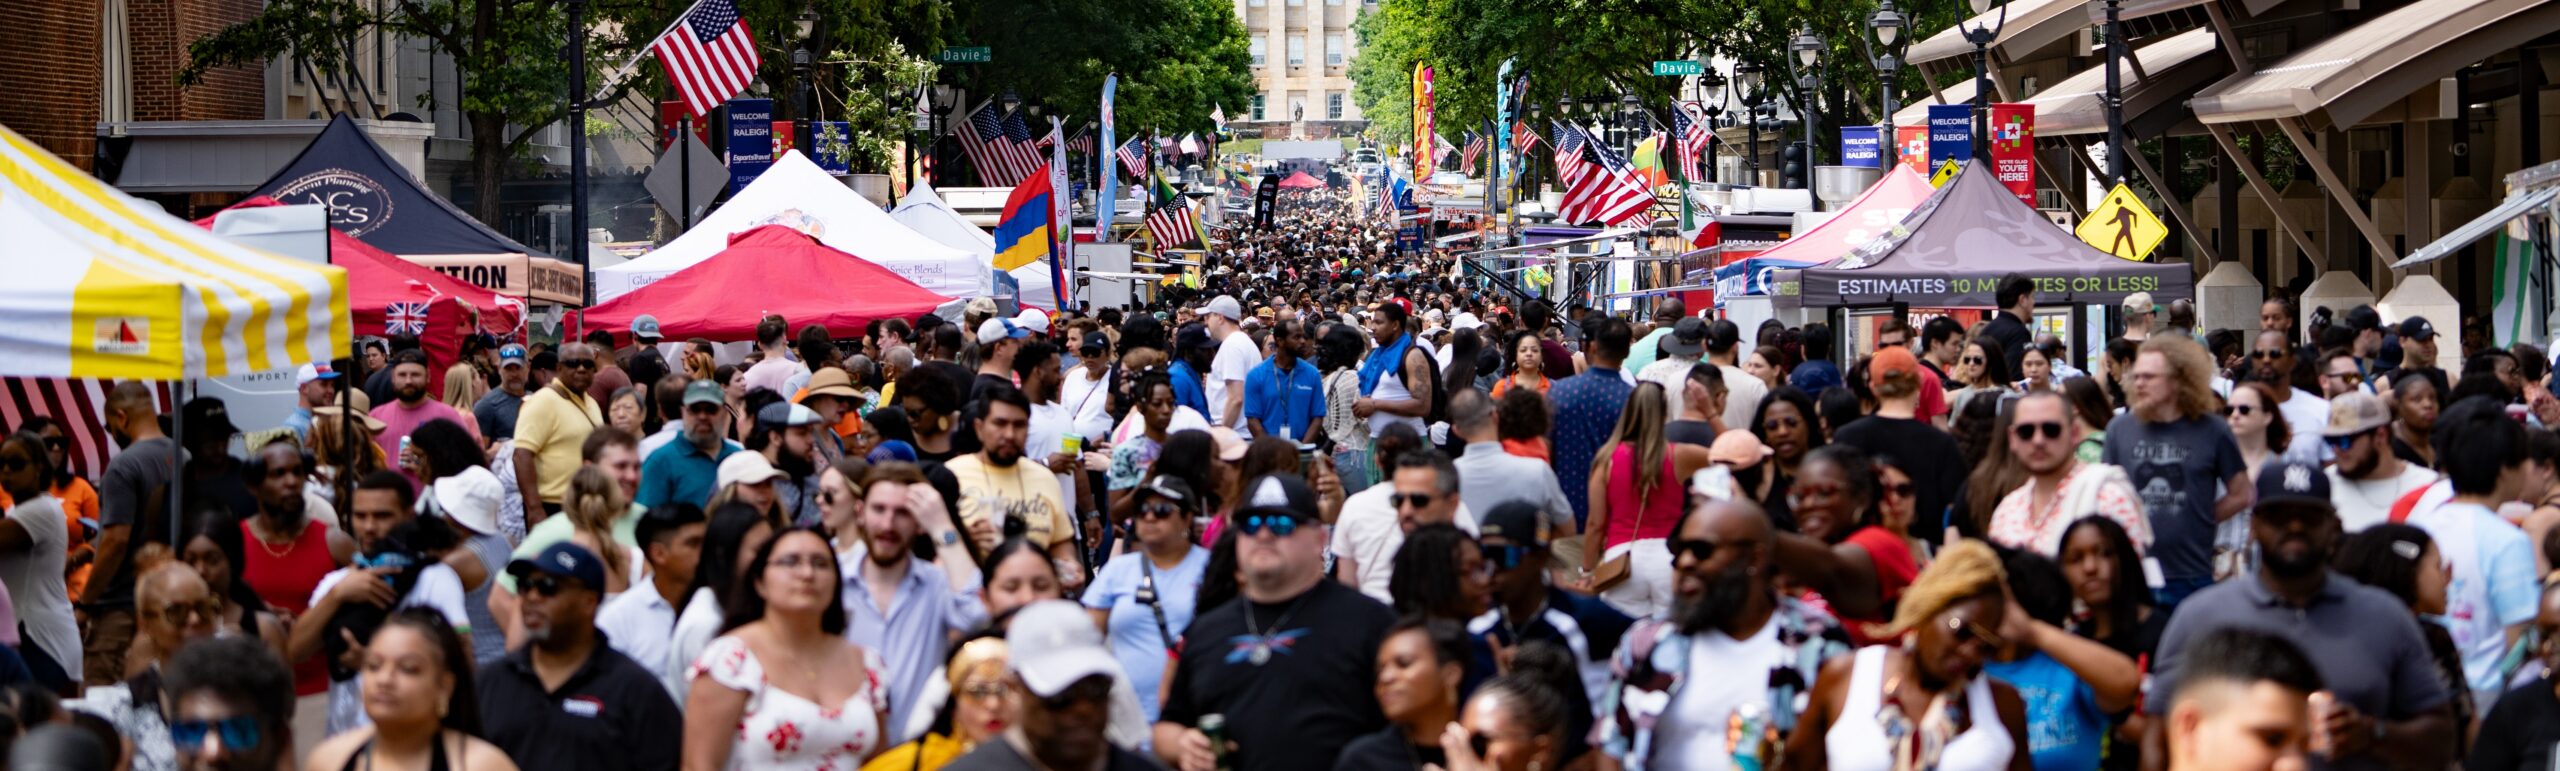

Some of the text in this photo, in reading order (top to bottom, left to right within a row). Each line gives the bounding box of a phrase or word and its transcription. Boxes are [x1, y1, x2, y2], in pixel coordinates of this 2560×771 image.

[943, 49, 980, 61] Davie
[1660, 62, 1696, 74] Davie
[732, 112, 770, 120] WELCOME
[1932, 118, 1970, 126] WELCOME
[733, 128, 769, 137] RALEIGH
[1933, 134, 1969, 142] RALEIGH
[732, 153, 771, 161] EsportsTravel
[1999, 164, 2029, 172] YOU'RE
[1998, 173, 2028, 182] HERE!
[288, 176, 373, 197] Event Planning
[307, 190, 355, 209] NC
[890, 263, 943, 275] Spice Blends
[1837, 275, 2159, 296] ESTIMATES 10 MTES OR LESS!
[243, 371, 289, 383] IMPORT
